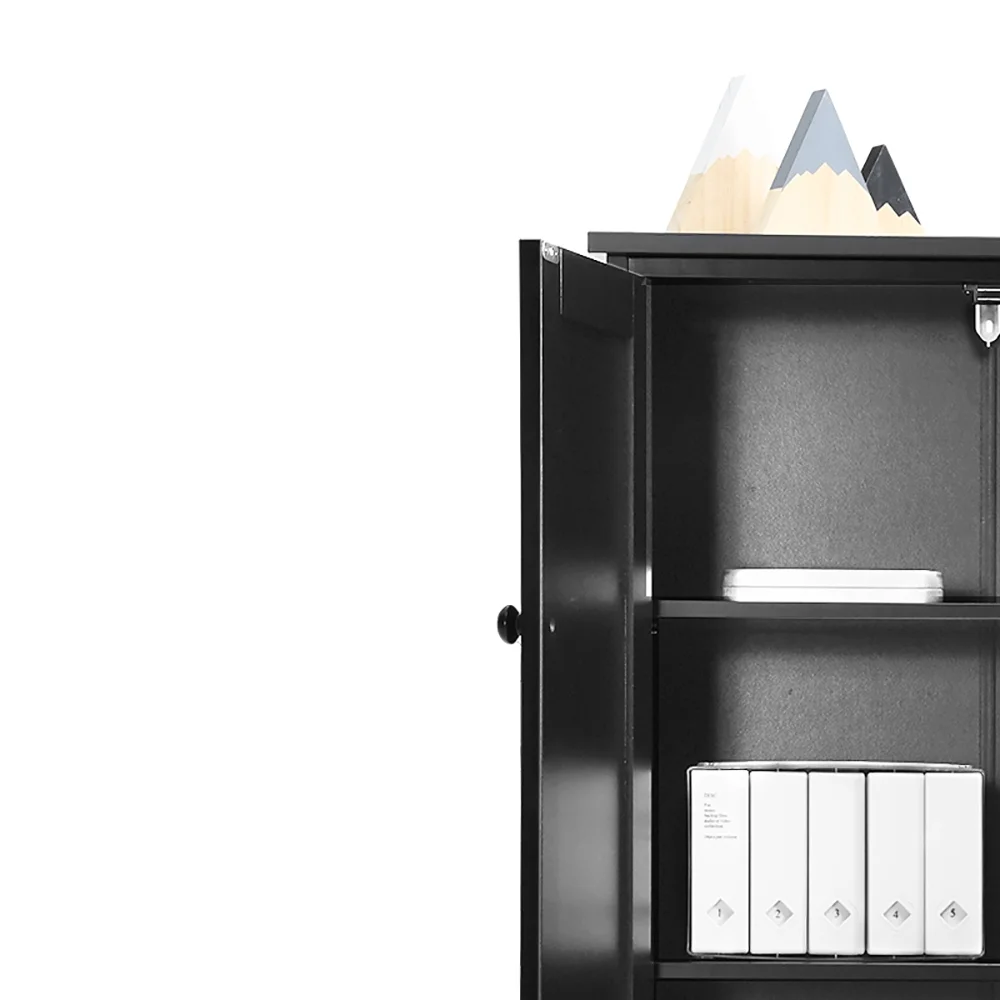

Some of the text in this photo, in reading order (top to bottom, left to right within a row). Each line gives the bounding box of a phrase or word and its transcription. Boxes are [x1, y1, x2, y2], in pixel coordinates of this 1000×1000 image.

[775, 909, 781, 918] 2
[834, 908, 840, 918] 3
[892, 909, 899, 919] 4
[949, 908, 956, 918] 5
